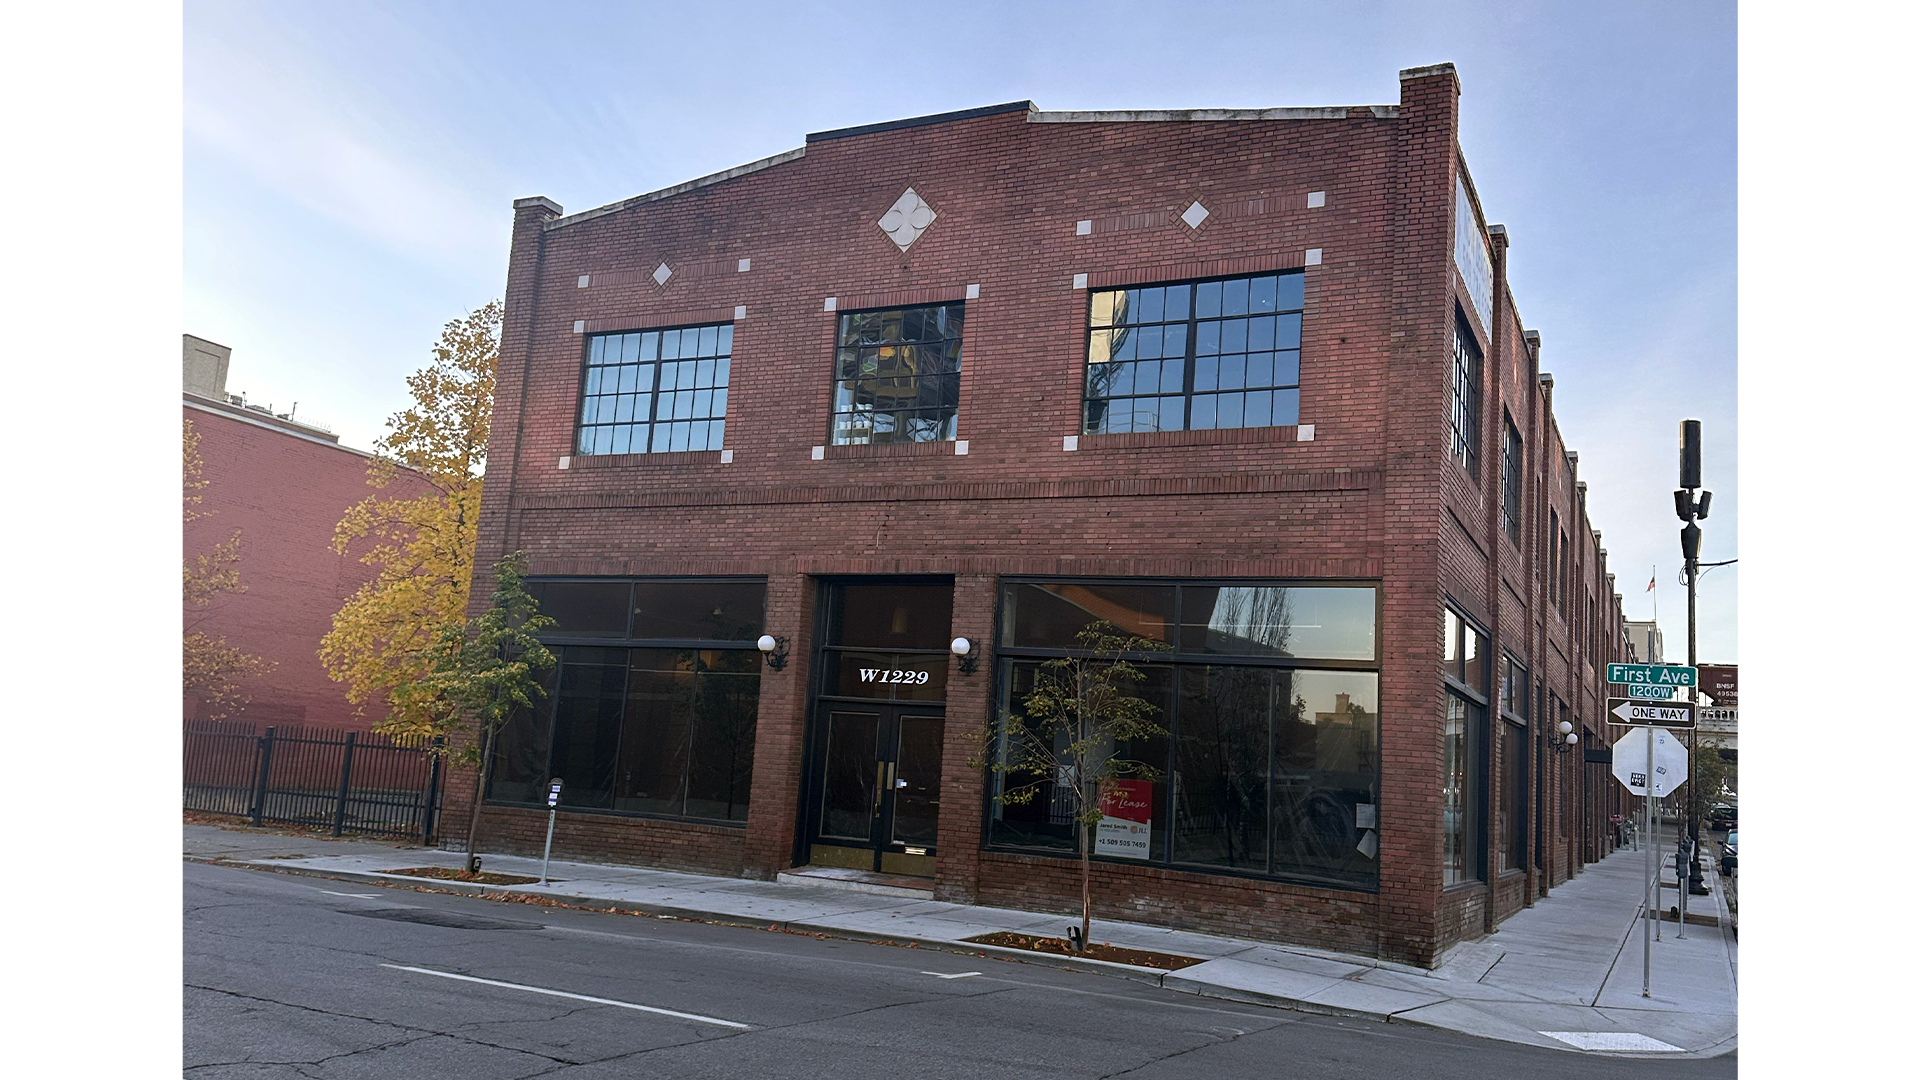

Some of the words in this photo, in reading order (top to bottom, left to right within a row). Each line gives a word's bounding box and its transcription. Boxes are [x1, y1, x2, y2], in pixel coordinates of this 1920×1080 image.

[859, 668, 929, 685] W1229
[1613, 666, 1651, 683] First
[1658, 669, 1690, 684] Ave
[1632, 686, 1670, 698] 1200W
[1632, 707, 1656, 718] ONE
[1660, 708, 1686, 720] WAY
[1101, 792, 1117, 805] For
[1118, 798, 1148, 808] Lease
[1107, 838, 1118, 846] 509
[1132, 840, 1146, 848] 7459
